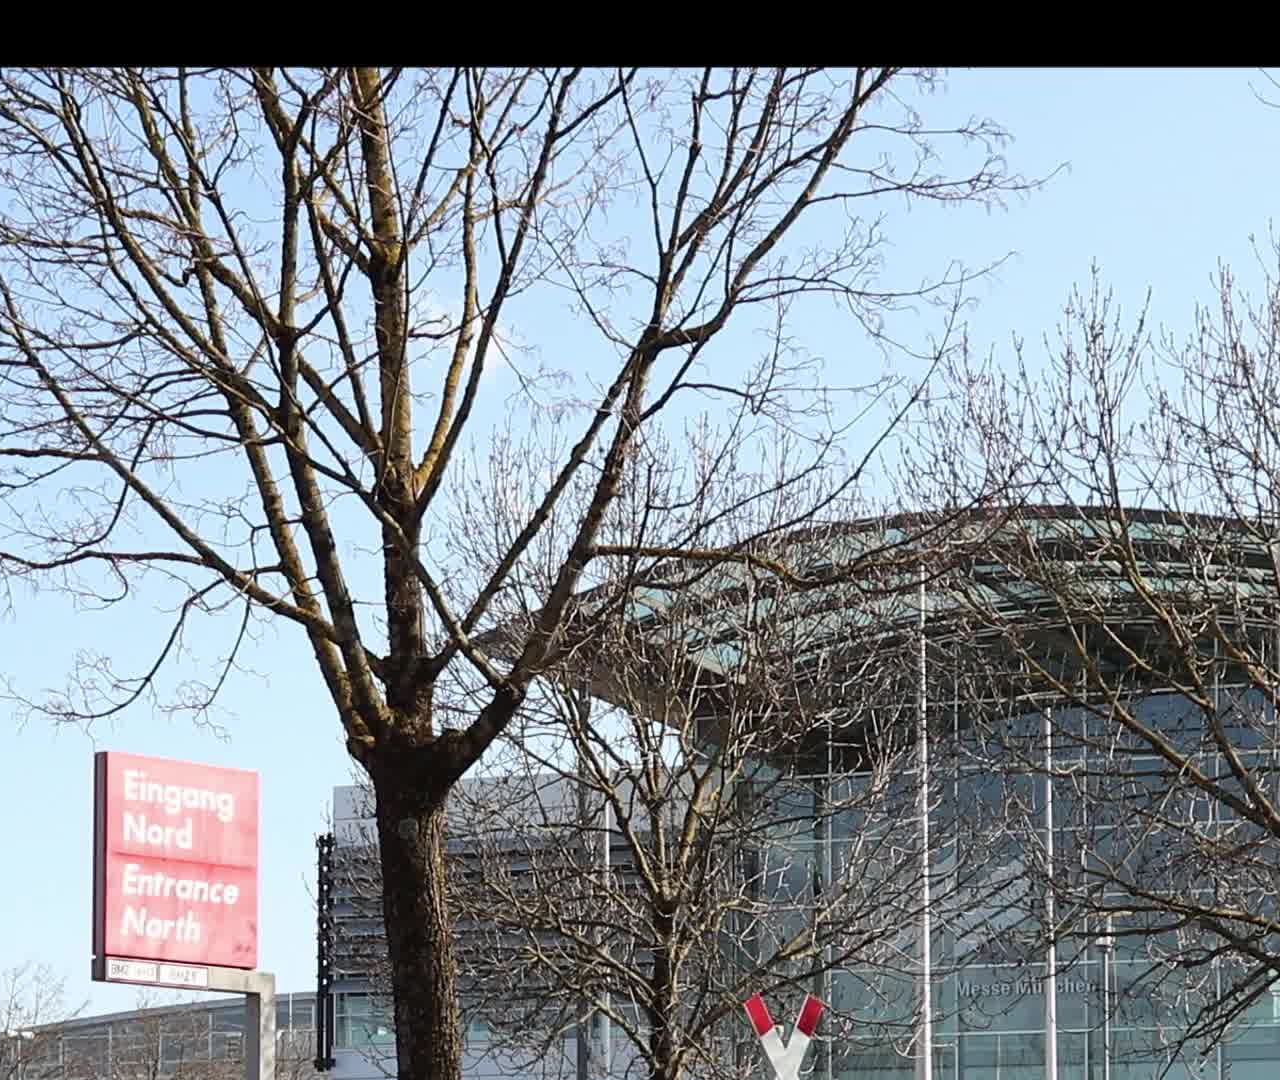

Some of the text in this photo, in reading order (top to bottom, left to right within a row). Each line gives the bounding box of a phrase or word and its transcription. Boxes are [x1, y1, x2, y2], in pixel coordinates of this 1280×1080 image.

[123, 769, 235, 822] Eingang
[123, 812, 193, 849] Nord
[122, 863, 240, 905] Entrance
[120, 906, 201, 944] North
